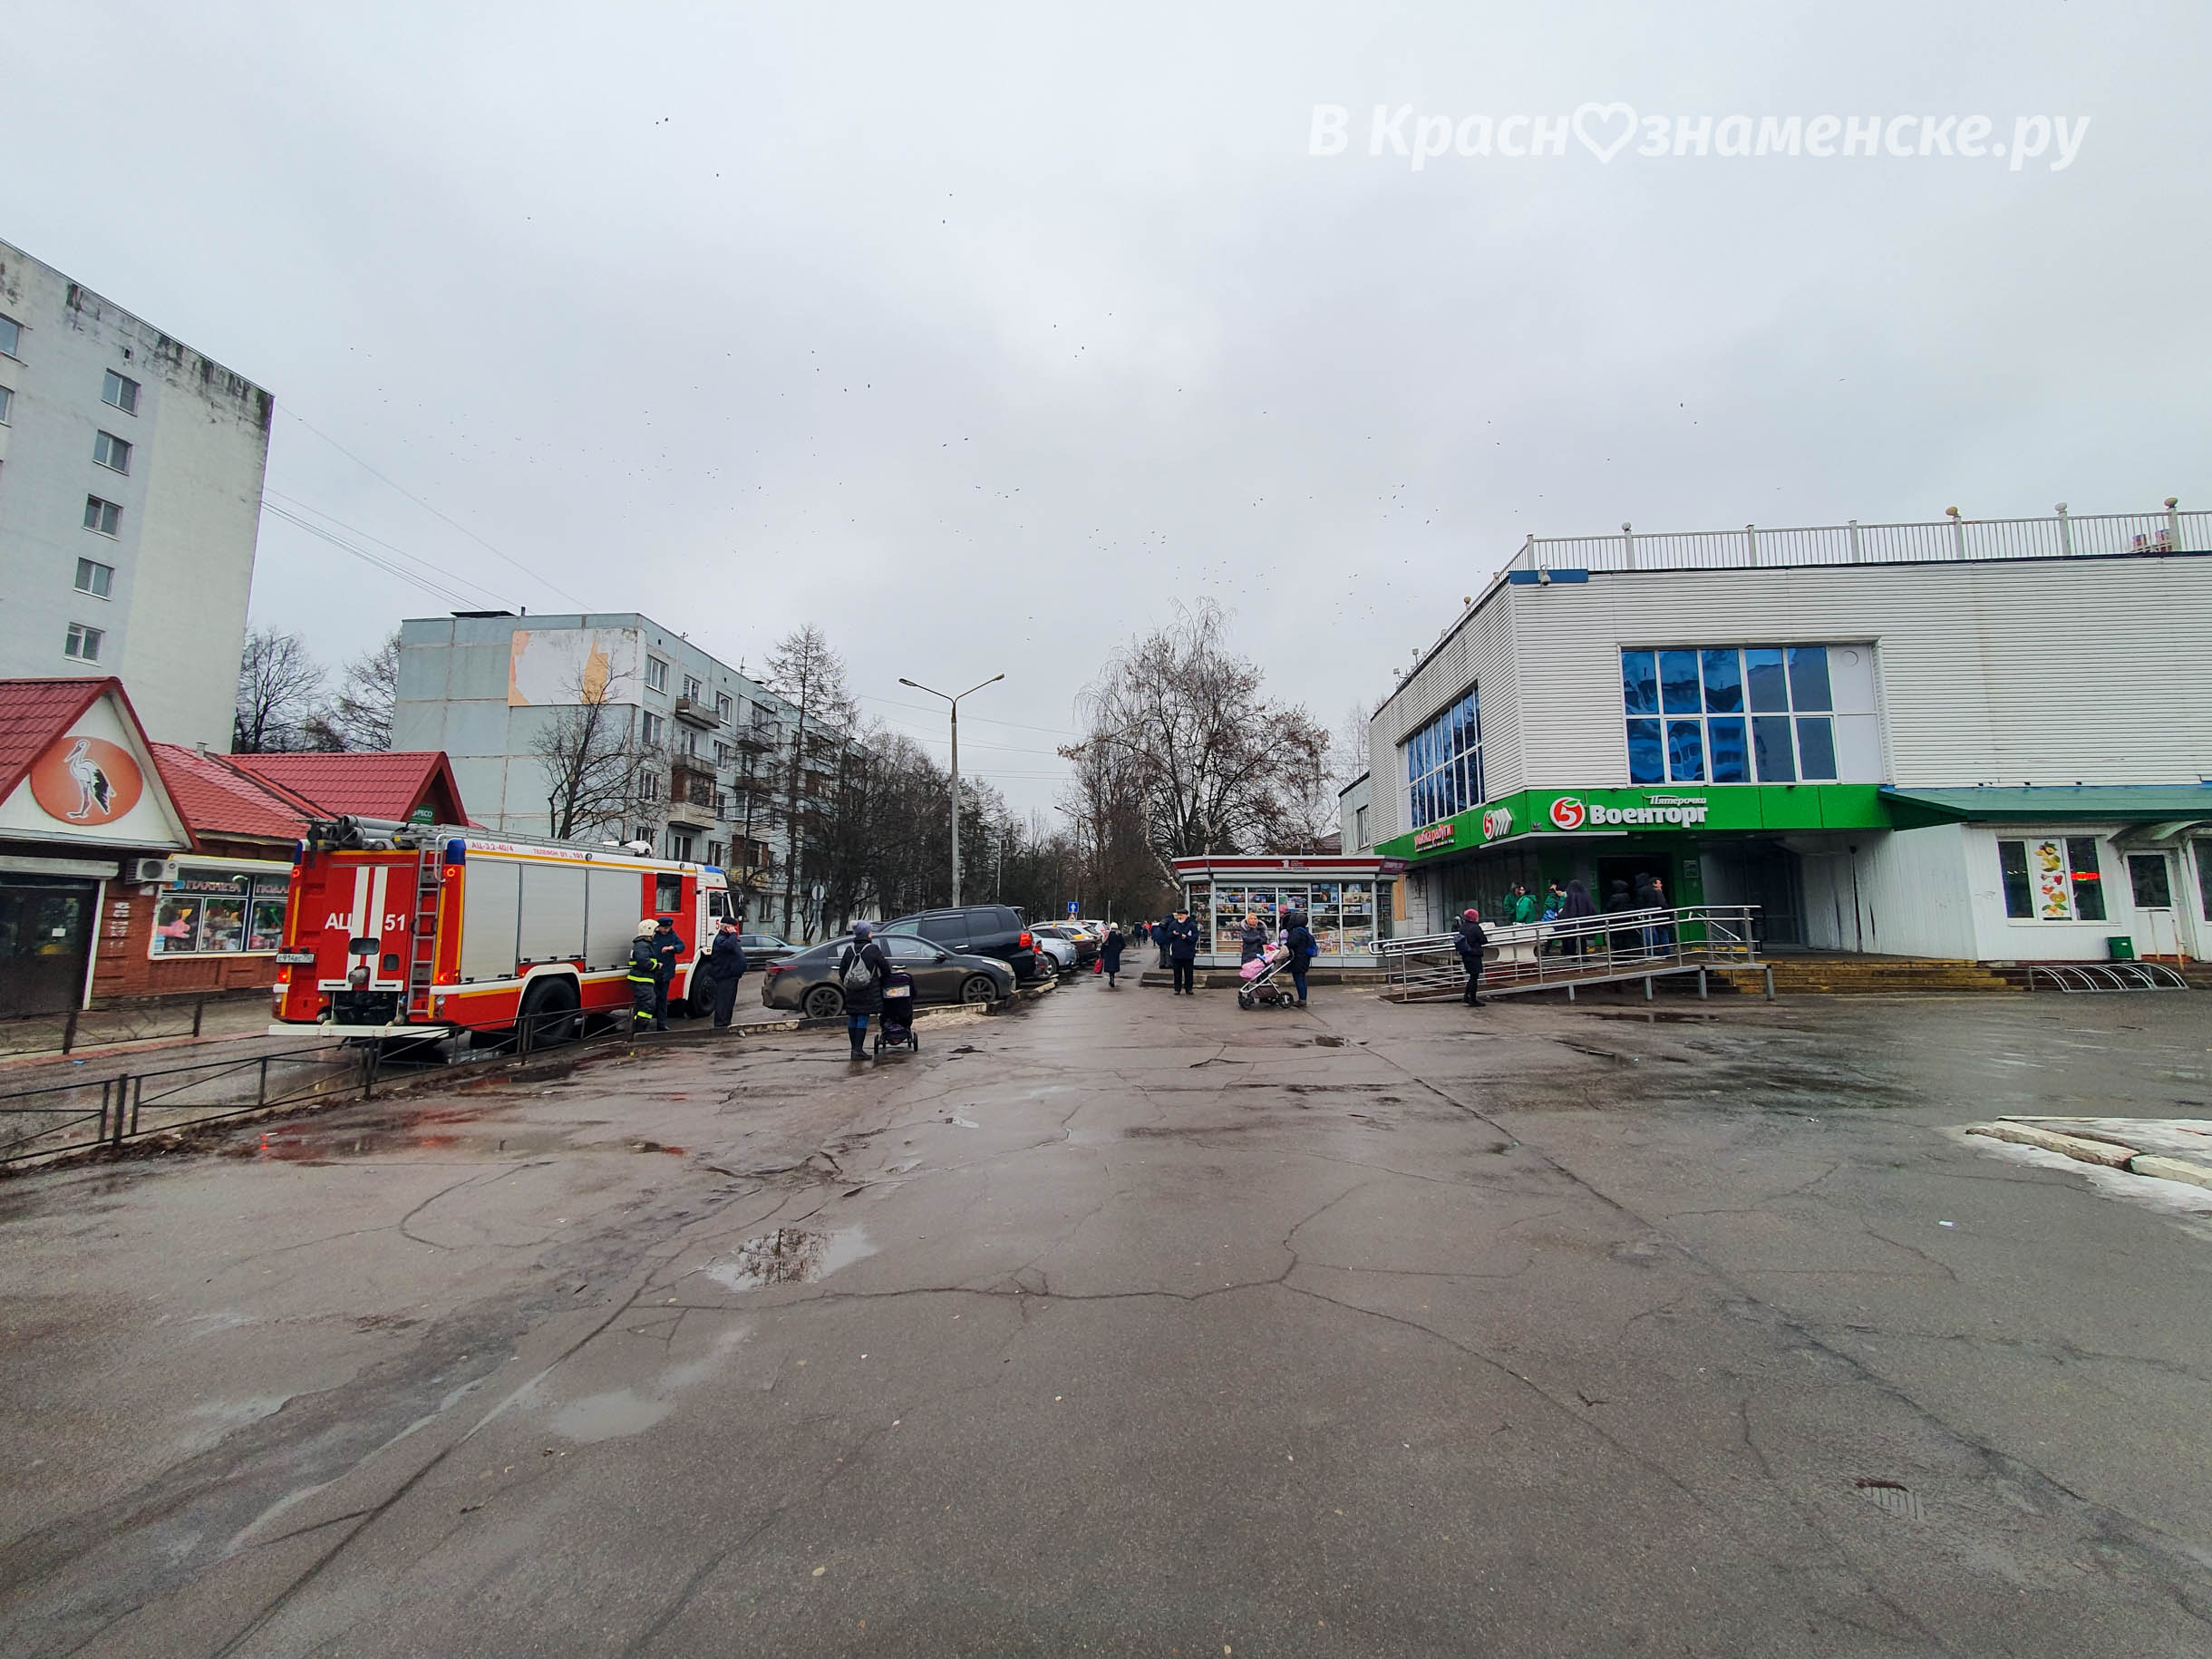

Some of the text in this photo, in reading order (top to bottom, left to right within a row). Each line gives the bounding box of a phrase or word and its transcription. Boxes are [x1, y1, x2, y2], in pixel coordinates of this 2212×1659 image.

[1589, 804, 1709, 828] Военторг
[325, 912, 405, 933] АЦ 51
